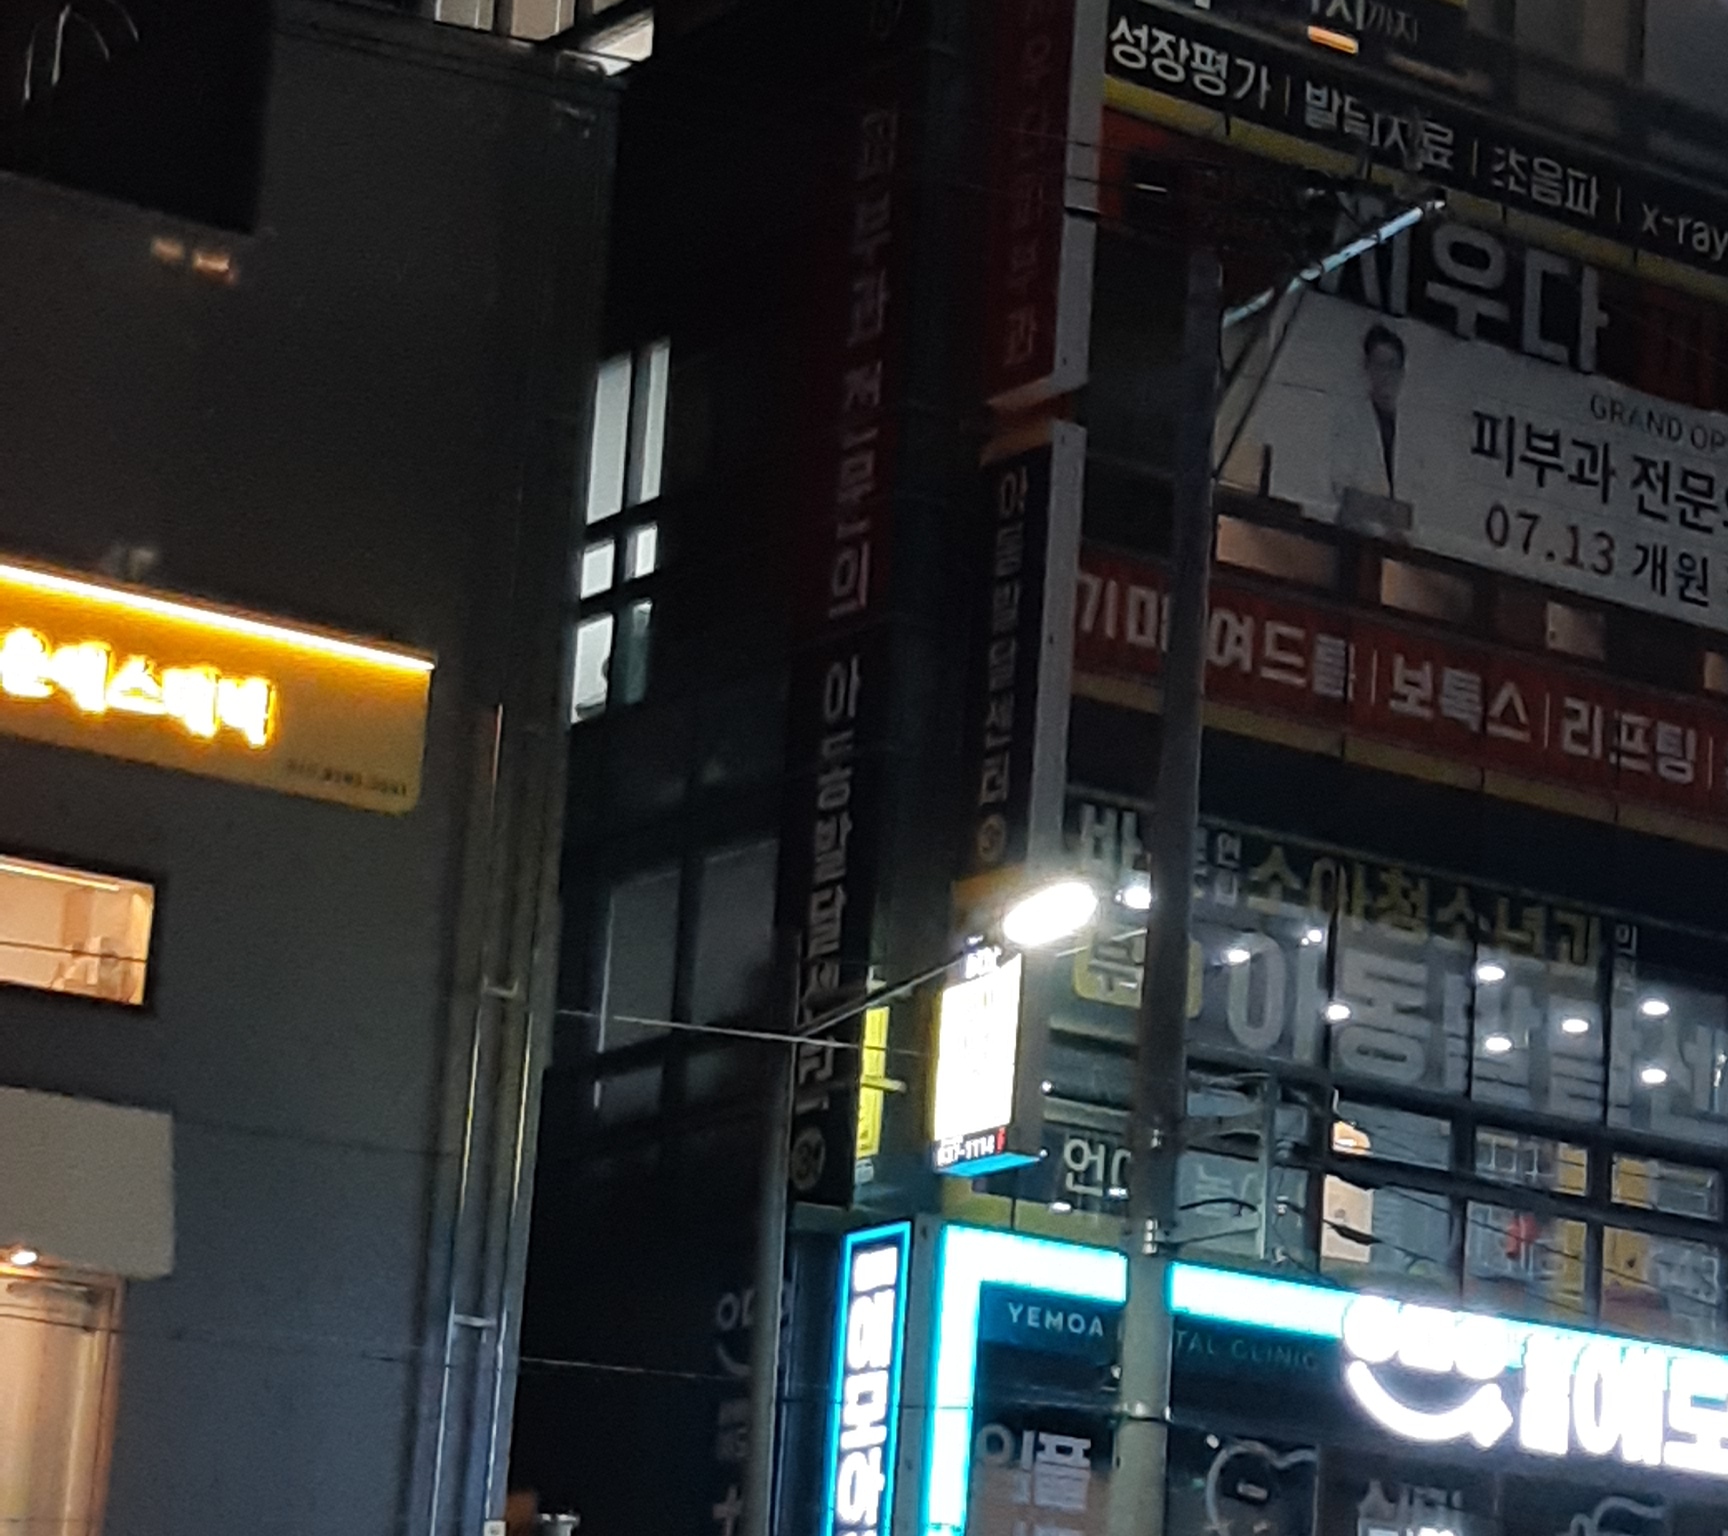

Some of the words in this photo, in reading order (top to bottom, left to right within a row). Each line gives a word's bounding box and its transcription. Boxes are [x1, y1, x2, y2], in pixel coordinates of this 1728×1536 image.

[1109, 15, 1272, 111] 성장평가
[1493, 146, 1600, 218] 초음파
[1470, 409, 1615, 504] 피부과
[1591, 394, 1683, 445] GRAND
[1485, 504, 1615, 576] 07.13
[1634, 543, 1708, 606] 개원
[1209, 608, 1355, 705] 여드름
[1391, 661, 1528, 742] 보톡스
[1561, 696, 1695, 786] 리프팅
[1006, 1300, 1105, 1337] YEMOA
